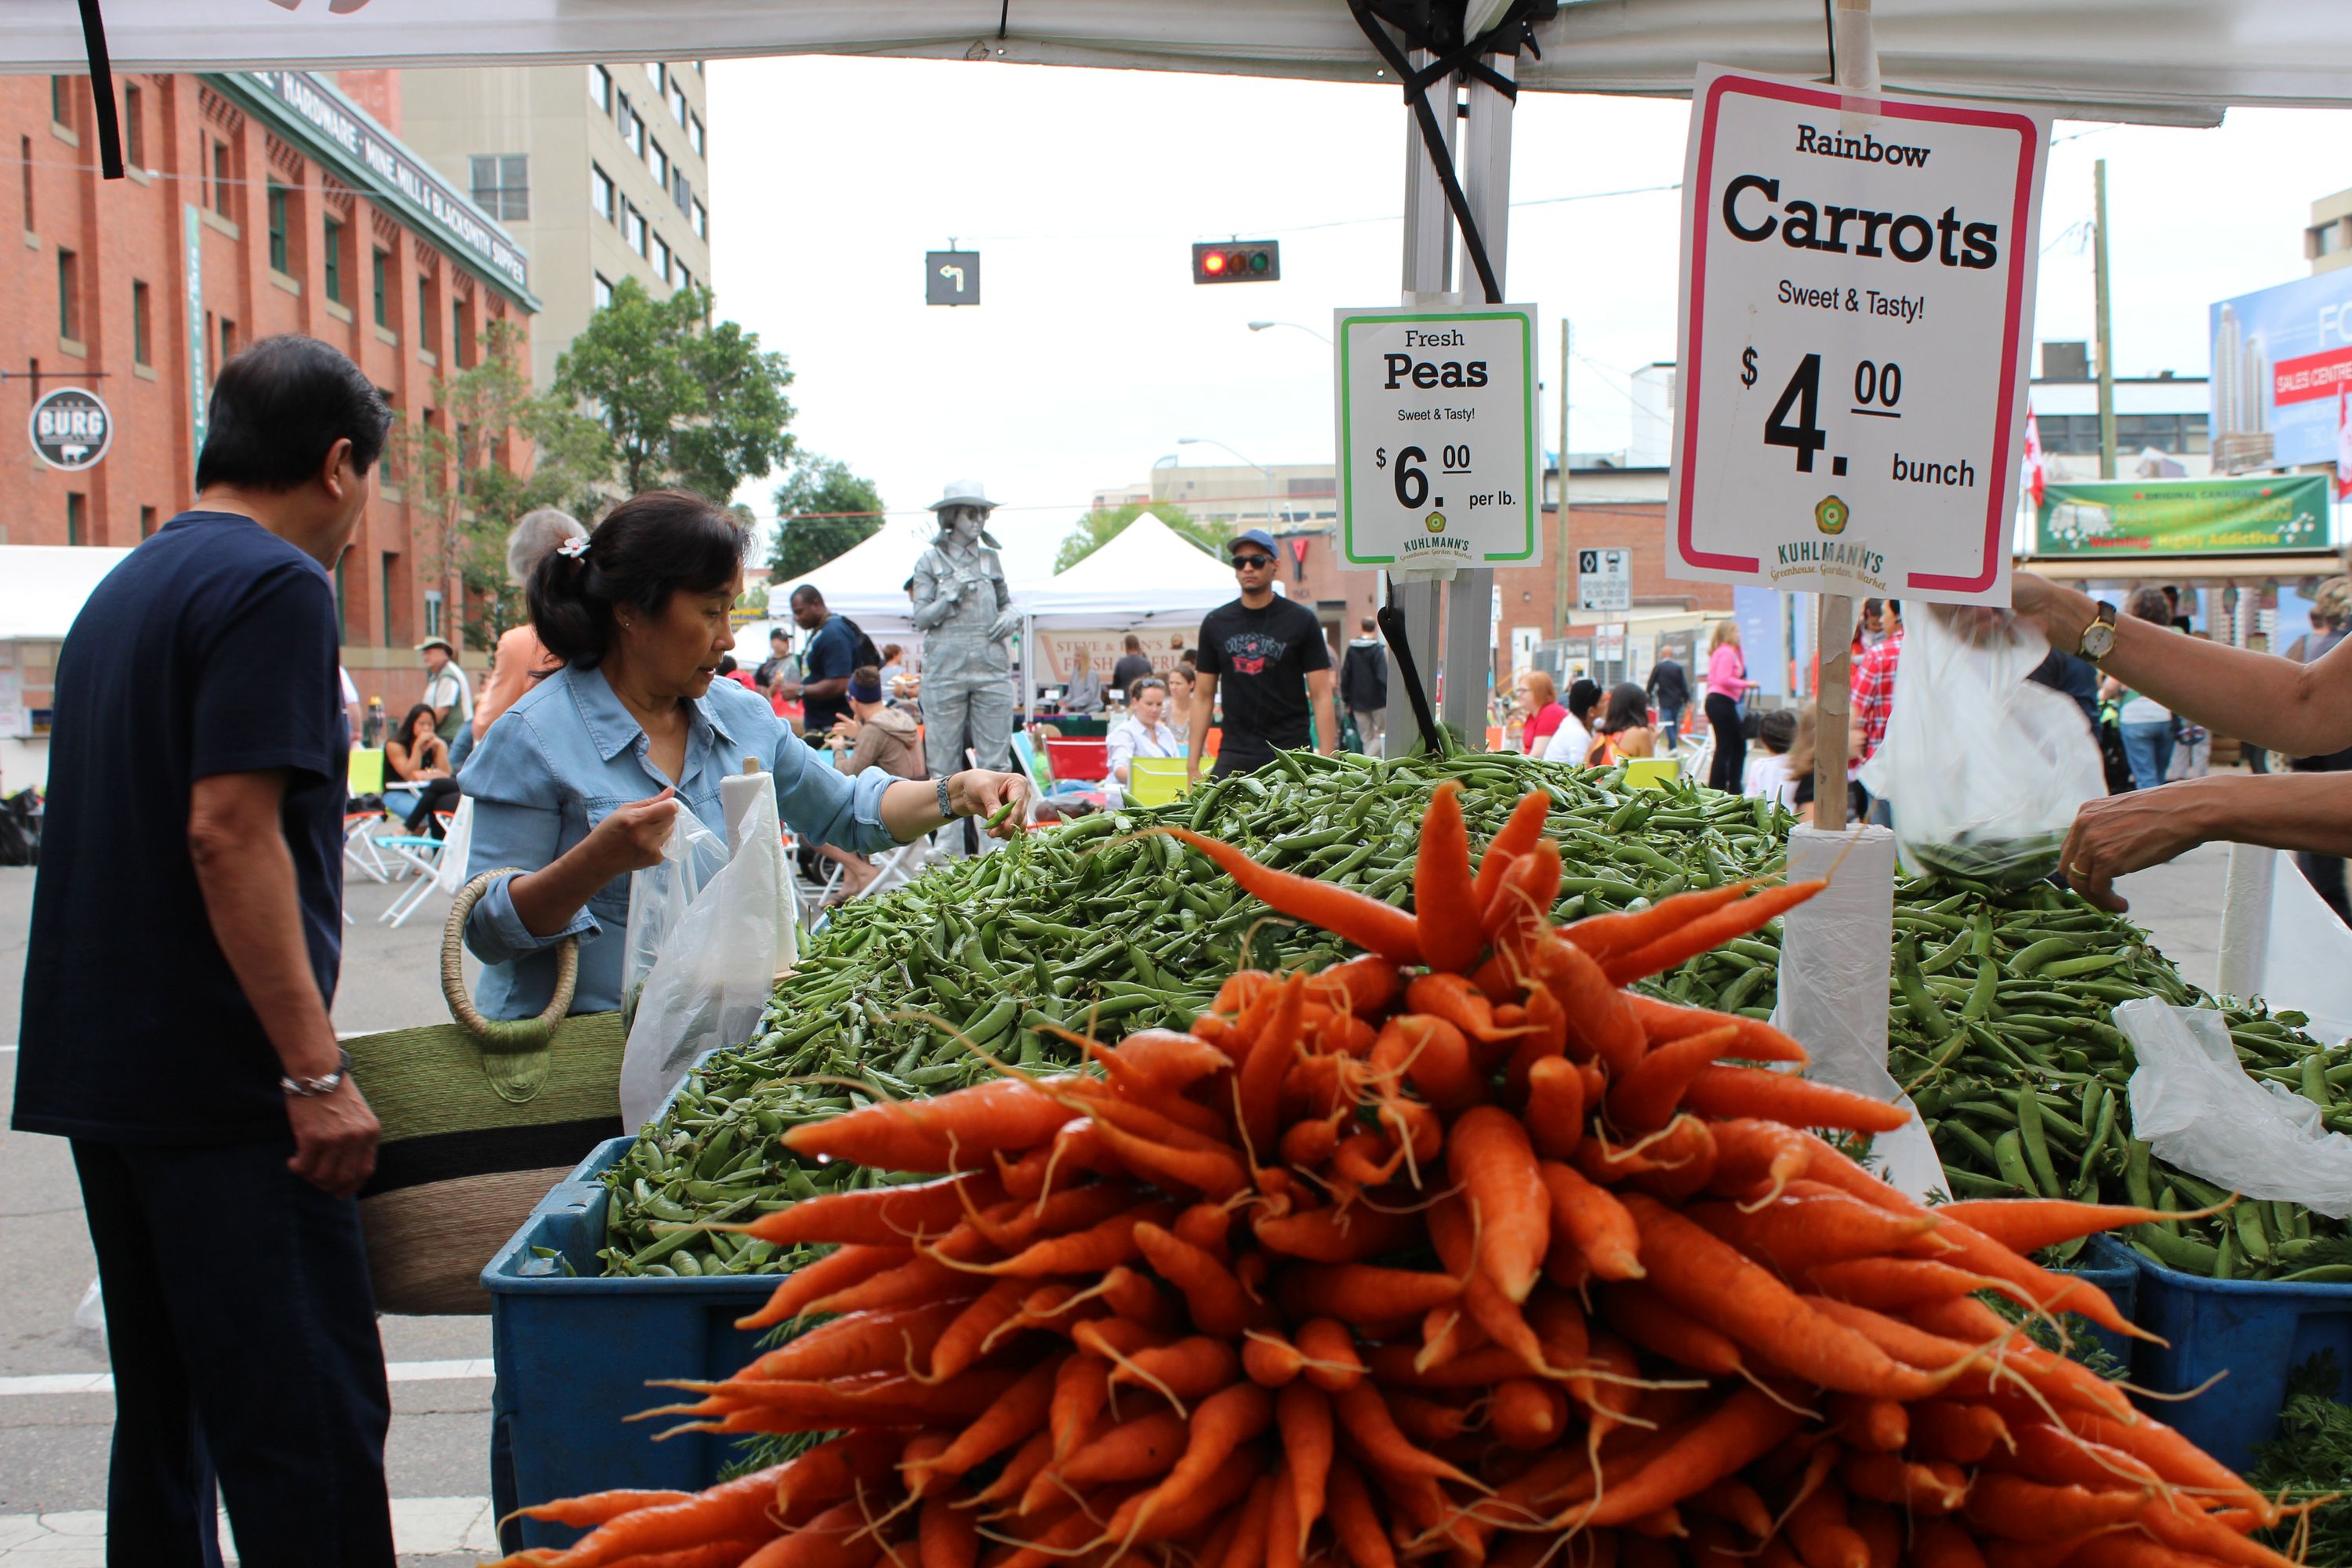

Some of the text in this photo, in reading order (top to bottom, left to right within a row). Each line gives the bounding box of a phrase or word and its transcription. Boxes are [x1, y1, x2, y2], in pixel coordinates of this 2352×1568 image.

[1795, 125, 1931, 168] Rainbow
[283, 71, 358, 155] HARDWARE
[432, 191, 492, 257] BLACKSMITH
[1722, 174, 1998, 269] Carrots
[1777, 280, 1924, 324] Sweet & Tasty!
[1405, 329, 1465, 347] Fresh
[1384, 354, 1488, 389] Peas
[2276, 361, 2352, 394] SALES CENTRE
[38, 409, 103, 436] BURG
[1398, 408, 1475, 422] Sweet & Tasty!
[1893, 453, 1975, 487] bunch
[1469, 491, 1515, 510] per lb.
[1403, 536, 1469, 553] KUHLMANN'S
[2157, 533, 2205, 549] Highly
[2208, 530, 2280, 545] Addictive
[1777, 541, 1884, 573] KUHLMANN'S
[1064, 657, 1113, 671] FSH
